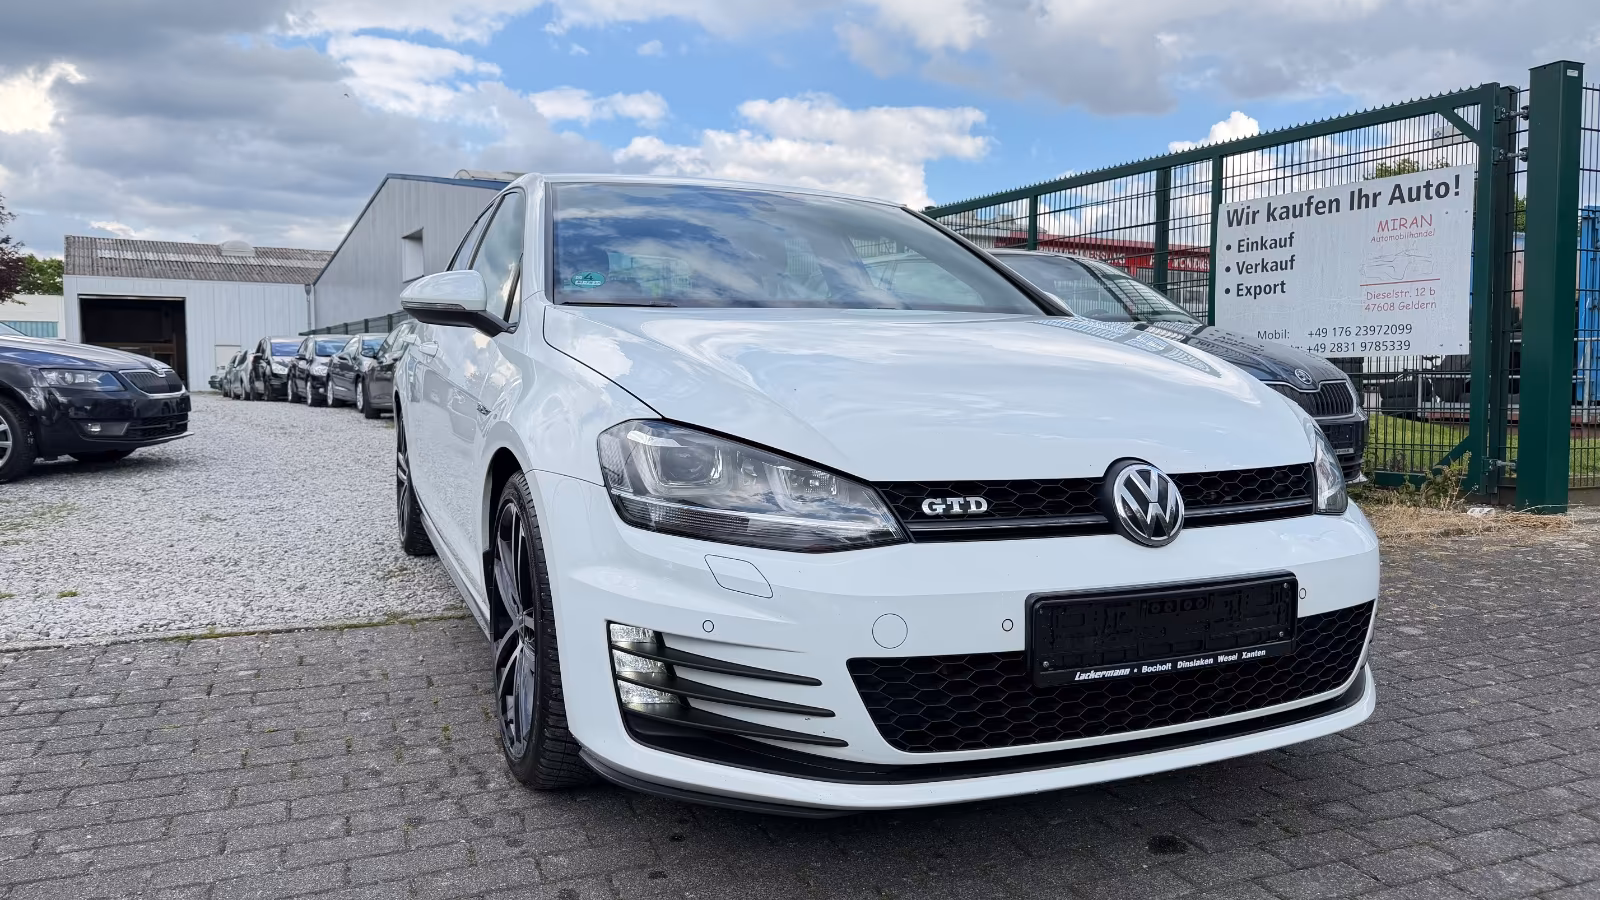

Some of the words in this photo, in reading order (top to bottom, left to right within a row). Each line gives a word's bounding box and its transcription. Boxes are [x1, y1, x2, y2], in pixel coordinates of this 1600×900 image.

[1226, 205, 1260, 227] Wir
[1266, 195, 1341, 222] kaufen
[1349, 188, 1382, 211] Ihr
[1388, 174, 1460, 206] Auto!
[1377, 213, 1433, 233] MIRAN
[1237, 231, 1295, 253] Einkauf
[1370, 228, 1436, 243] Automobilhandel
[1236, 254, 1296, 275] Verkauf
[1236, 280, 1287, 300] Export
[1366, 289, 1412, 301] Dieselstr.
[1415, 287, 1426, 297] 12
[1429, 286, 1436, 296] b
[1364, 302, 1395, 313] 47608
[1398, 300, 1437, 311] Geldern
[1257, 329, 1290, 340] Mobil:
[1308, 327, 1328, 338] +49
[1332, 326, 1352, 337] 176
[1355, 323, 1413, 336] 23972099
[1306, 342, 1327, 353] +49
[1330, 341, 1355, 353] 2831
[1360, 339, 1411, 352] 9785339
[921, 496, 988, 516] GTD
[1074, 667, 1131, 681] Lackermann
[1141, 662, 1172, 674] Bocholt
[1176, 657, 1214, 669] Dinslaken
[1217, 652, 1239, 663] Wesel
[1241, 649, 1266, 659] Xanten
